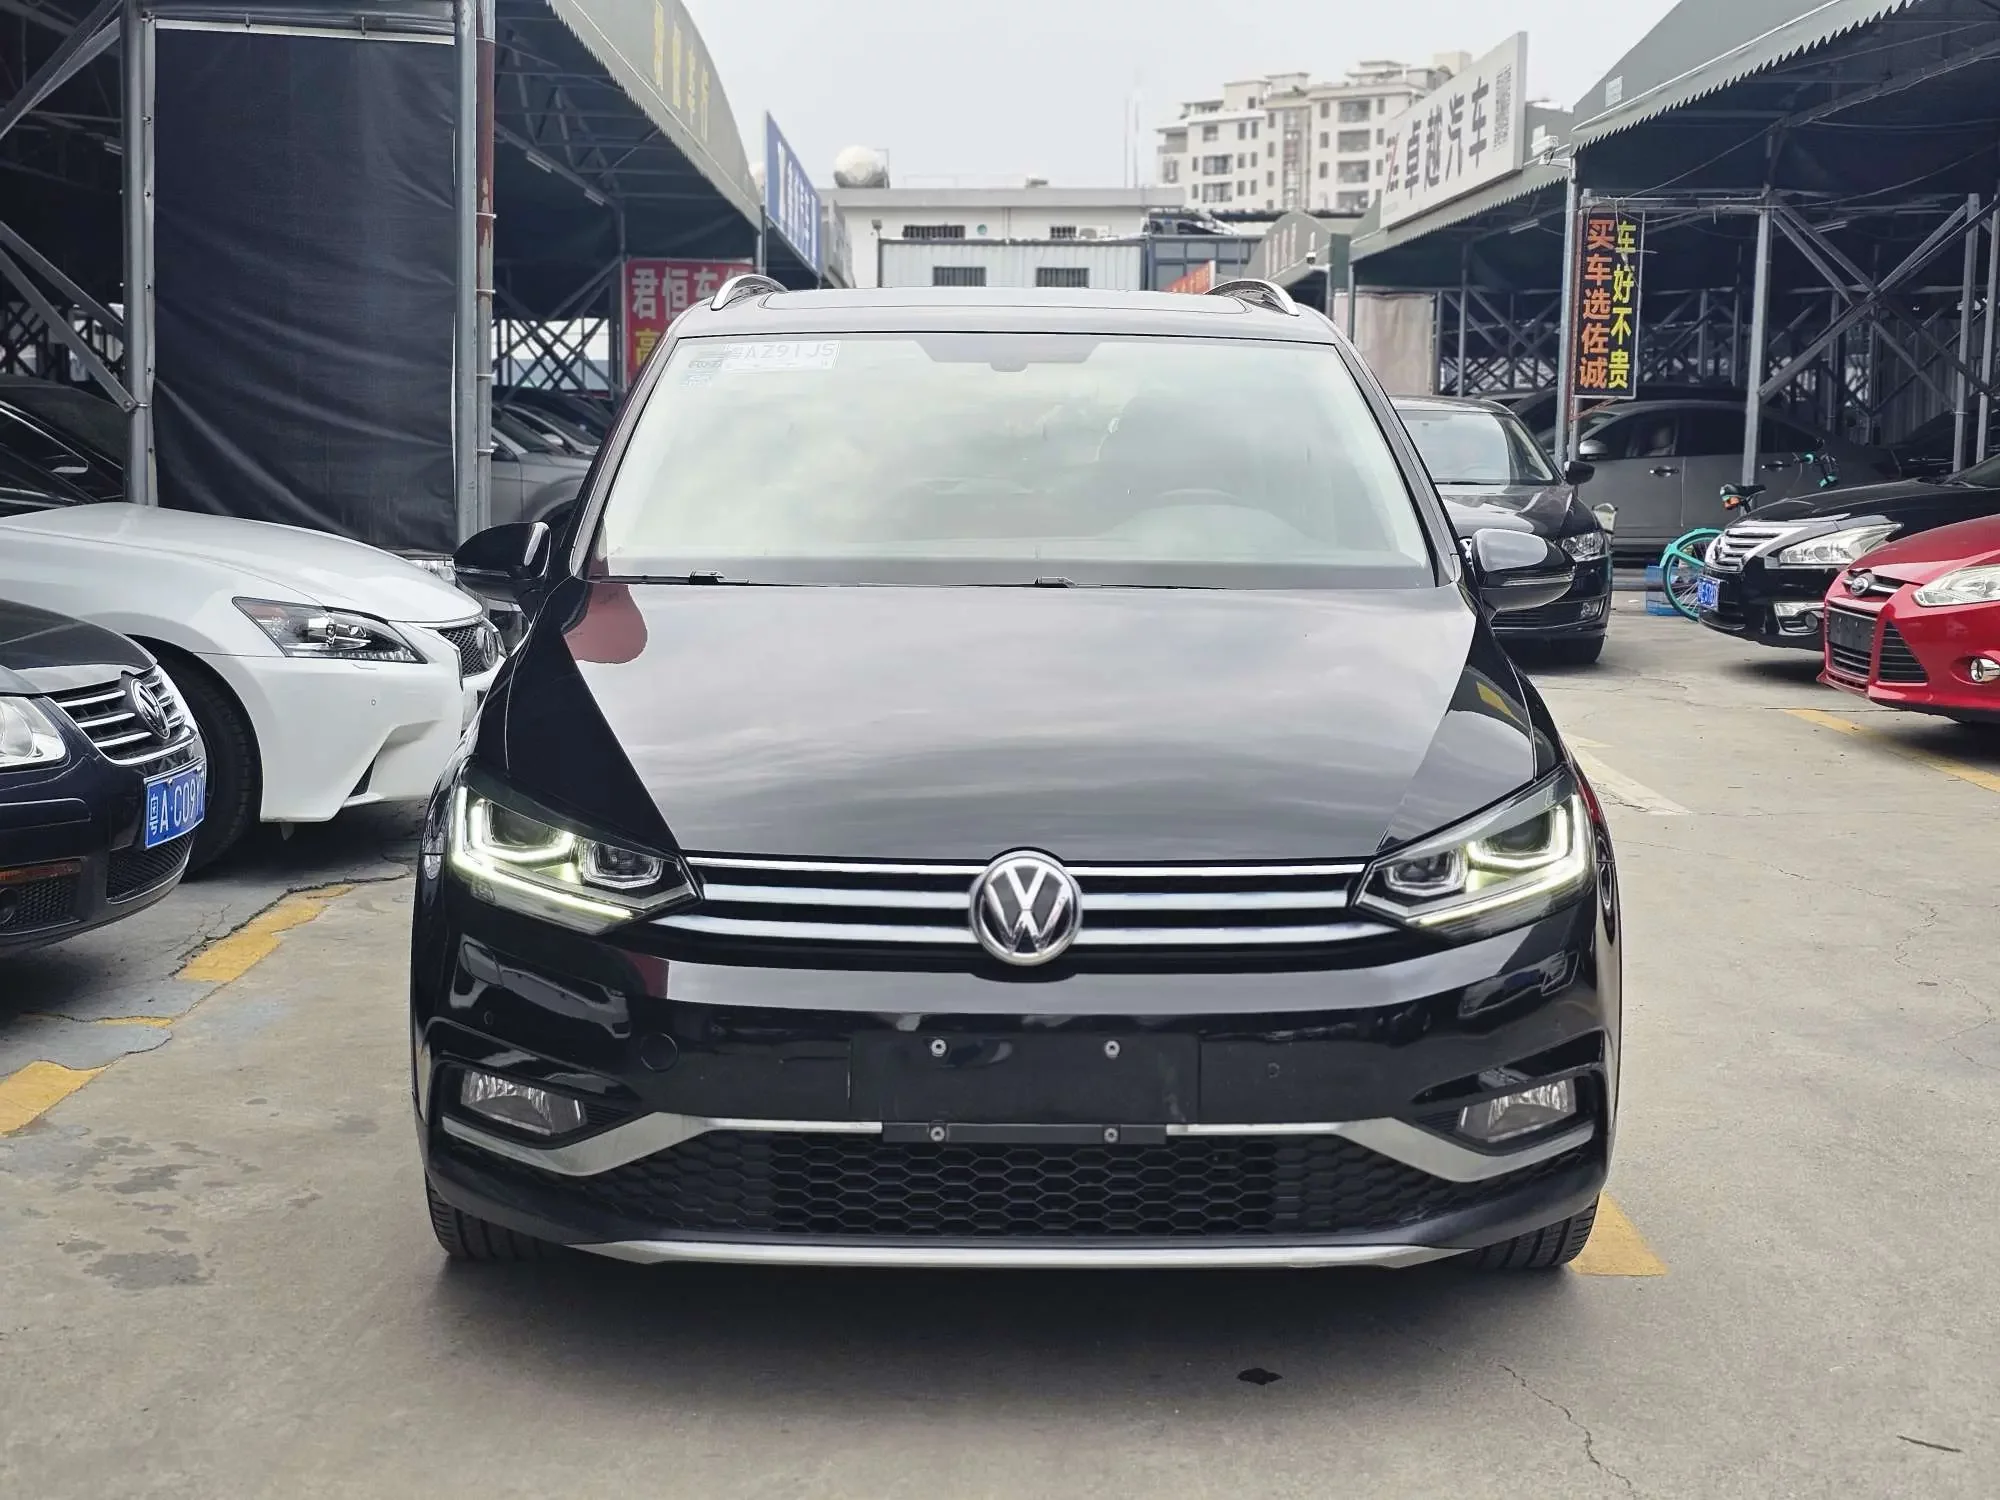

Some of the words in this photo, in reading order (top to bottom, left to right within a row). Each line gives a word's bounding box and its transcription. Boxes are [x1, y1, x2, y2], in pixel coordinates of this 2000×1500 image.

[1404, 76, 1489, 200] 卓越汽车
[631, 266, 750, 320] 君恒车
[1579, 219, 1616, 389] 买车选佐诚
[1608, 220, 1637, 389] 车好不贵
[976, 851, 1077, 960] VW
